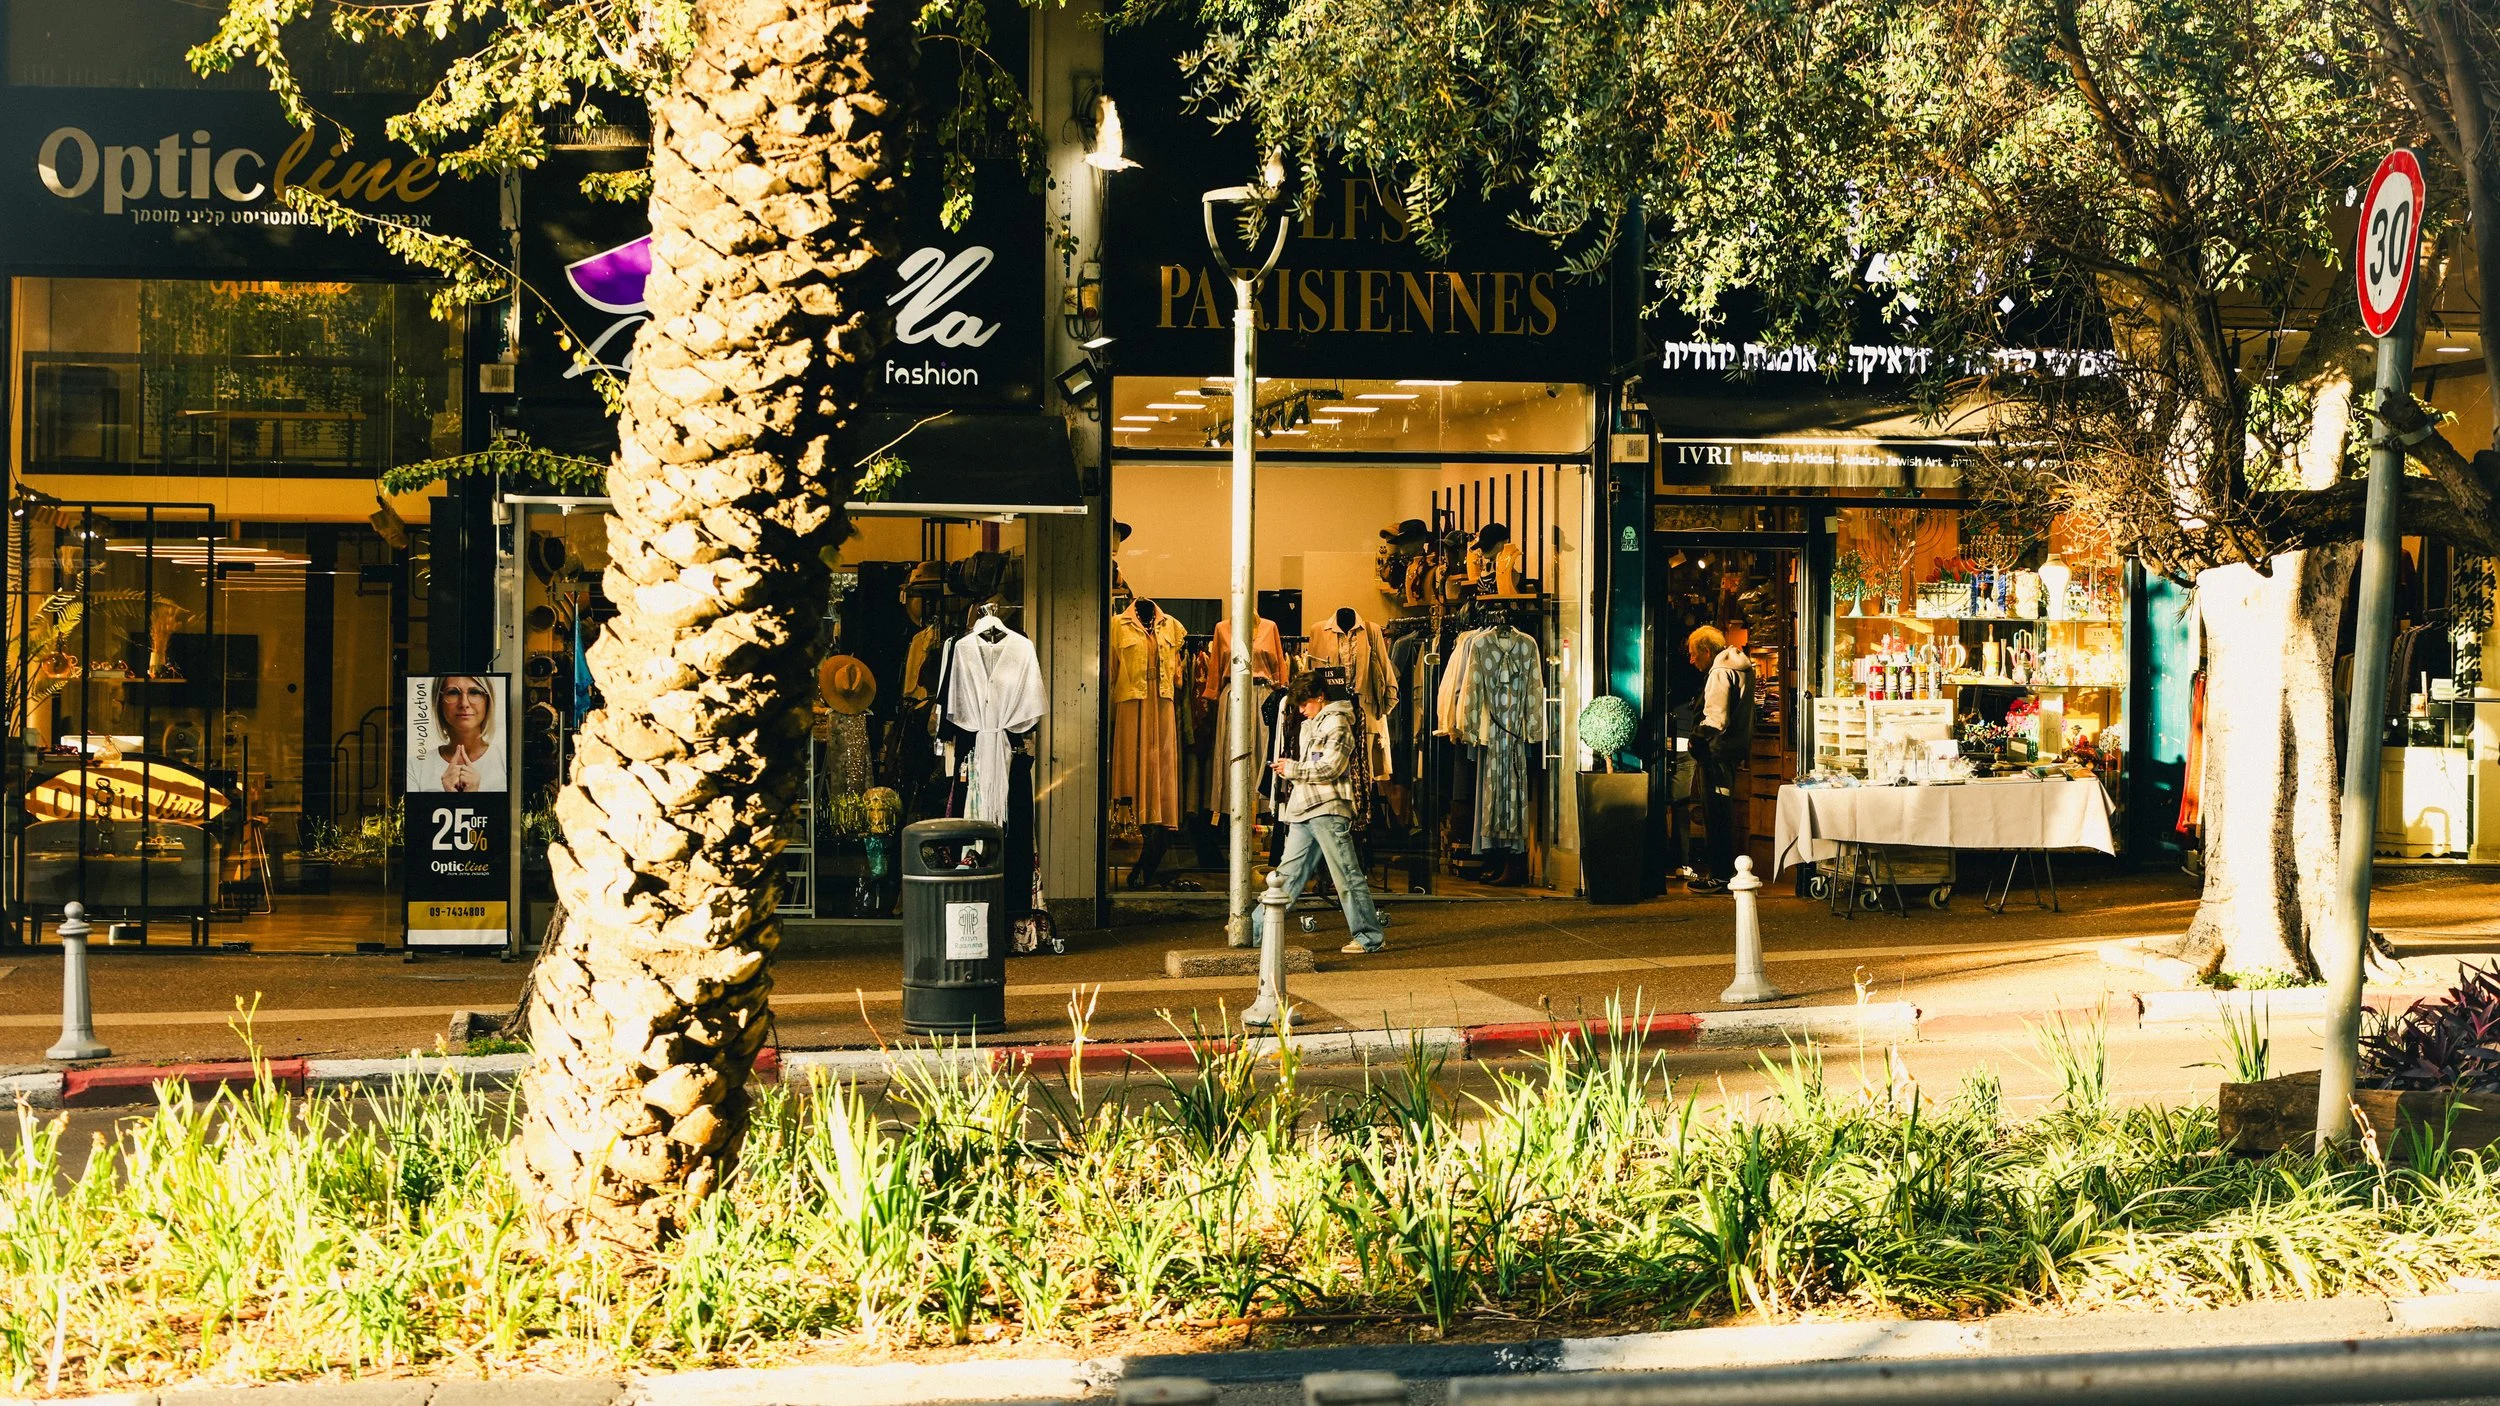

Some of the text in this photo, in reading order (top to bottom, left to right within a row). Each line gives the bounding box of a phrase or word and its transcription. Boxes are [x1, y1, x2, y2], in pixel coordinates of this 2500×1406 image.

[130, 208, 180, 225] מוסמך
[186, 208, 225, 226] קליני
[2369, 200, 2410, 285] 30
[1156, 264, 1557, 336] PARISIENNES
[1662, 341, 1735, 371] יהודית
[885, 359, 979, 386] fashion
[1678, 446, 1943, 468] IVRI Religious Articles Judaica Jewish Art
[432, 807, 488, 851] 25 OFF
[430, 860, 489, 874] Opticline
[429, 907, 486, 917] 09-7434808
